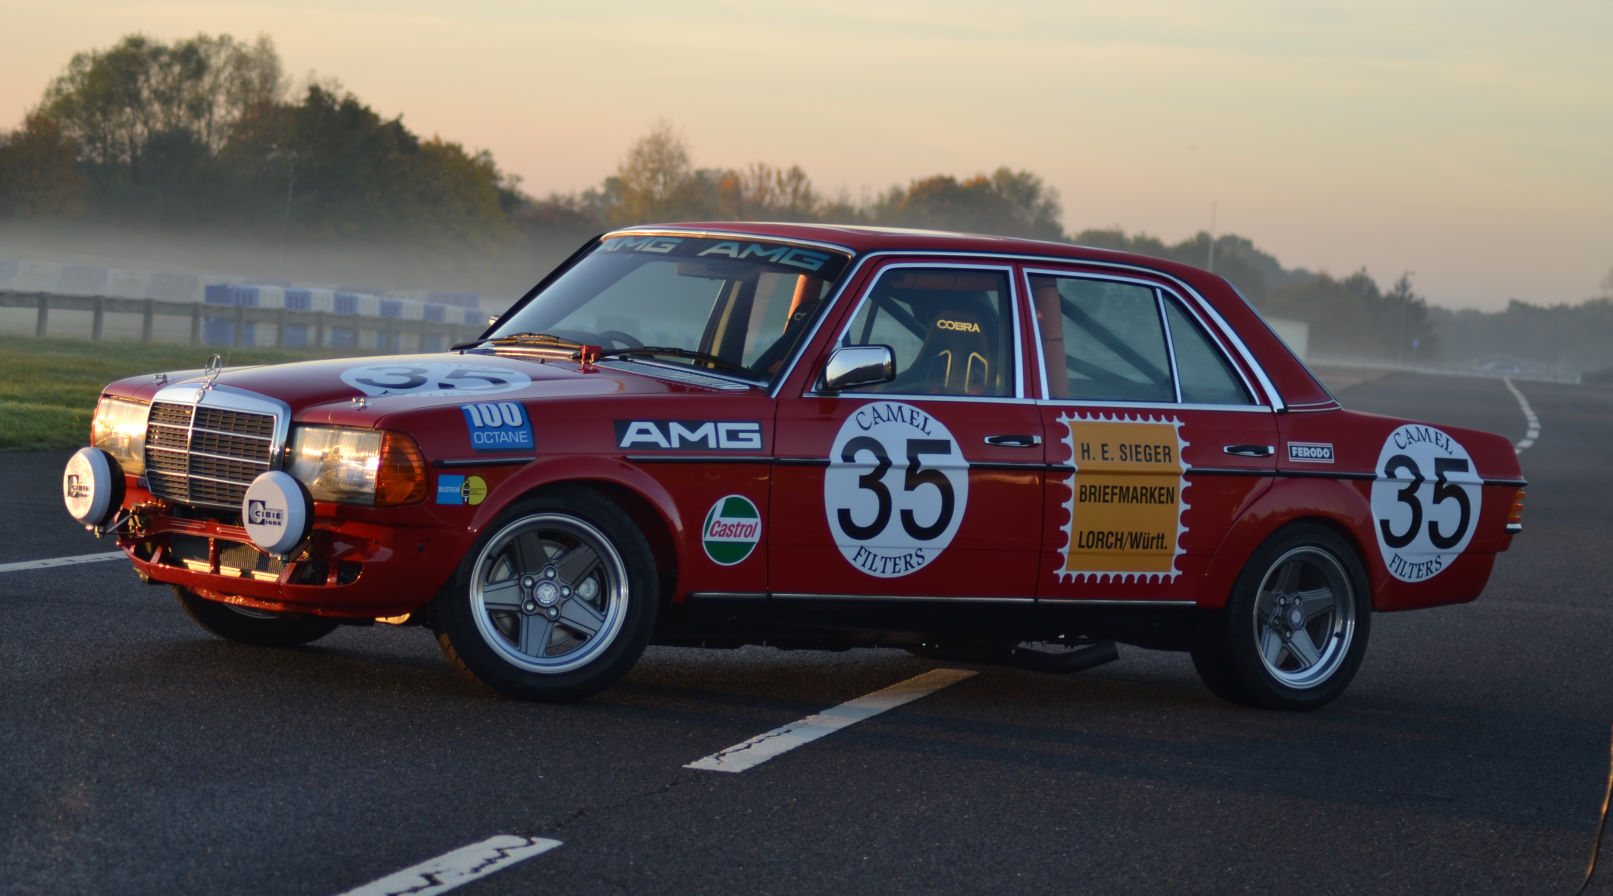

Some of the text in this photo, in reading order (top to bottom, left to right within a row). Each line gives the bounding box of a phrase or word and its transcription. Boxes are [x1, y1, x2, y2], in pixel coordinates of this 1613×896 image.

[697, 242, 832, 272] AMG
[937, 319, 981, 333] COBRA
[355, 366, 514, 392] 35
[461, 402, 523, 428] 100
[855, 404, 932, 436] CAMEL
[473, 431, 529, 444] OCTANE
[619, 421, 762, 449] AMG
[1393, 426, 1454, 455] CAMEL
[1081, 443, 1172, 463] H. E. SIEGER
[1291, 446, 1330, 458] FERODO
[837, 435, 955, 541] 35
[1079, 484, 1175, 505] BRIEFMARKEN
[1379, 454, 1471, 550] 35
[255, 511, 281, 520] CIBIE
[709, 519, 759, 539] Castrol
[1078, 530, 1168, 551] LORCH/Württ.
[852, 545, 925, 575] FILTERS
[1389, 552, 1443, 579] FILTERS
